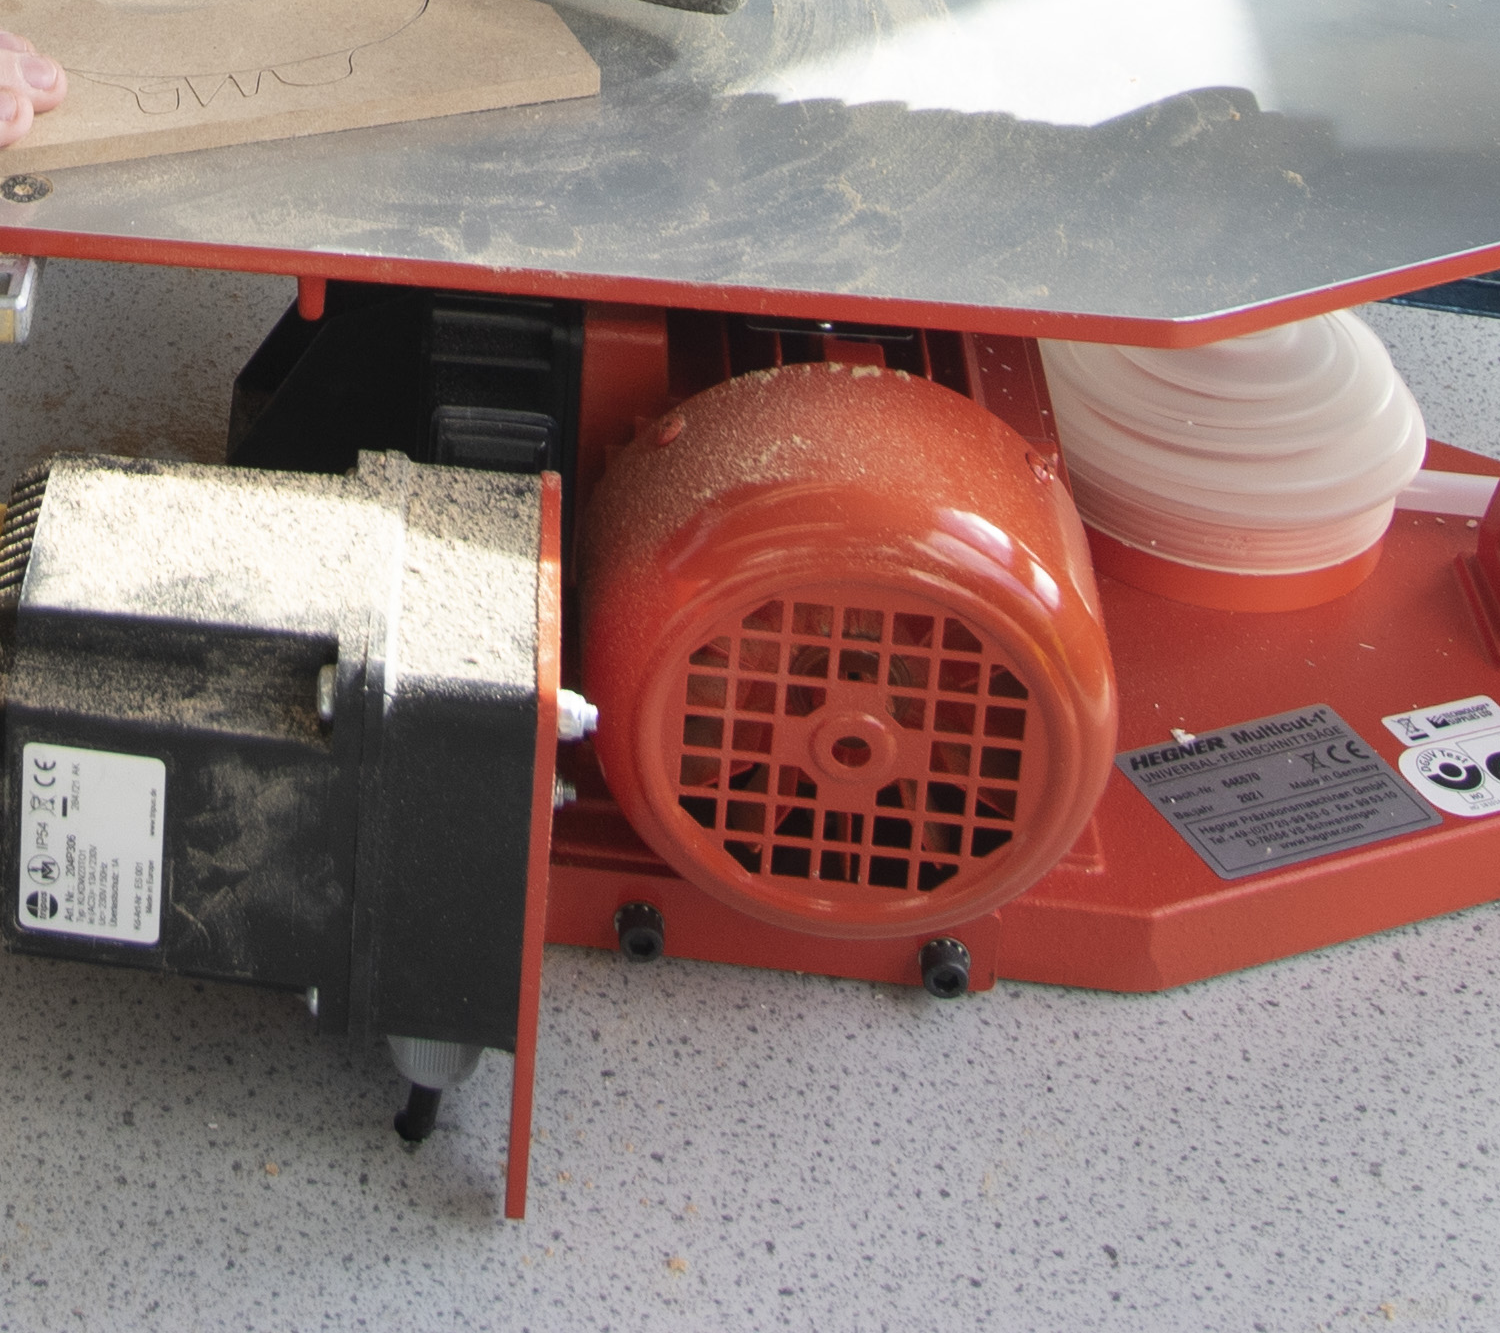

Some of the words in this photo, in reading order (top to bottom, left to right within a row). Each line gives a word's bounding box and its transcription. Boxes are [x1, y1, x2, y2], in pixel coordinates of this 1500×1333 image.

[1129, 735, 1227, 770] HEGNER
[1137, 724, 1345, 783] UNIVERSAL-FEINSCHNITTSÄGE
[1436, 748, 1469, 763] Test
[1287, 776, 1321, 790] Made
[1318, 773, 1333, 782] in
[1331, 761, 1381, 780] Germany
[1172, 803, 1217, 821] Baujahr
[1235, 789, 1265, 803] 2021
[1197, 818, 1242, 836] Hegner
[1350, 779, 1389, 795] GmbH
[1333, 800, 1356, 811] Fax
[36, 820, 48, 849] IP54
[1278, 821, 1366, 850] www.hegner.com
[40, 890, 48, 919] tripus
